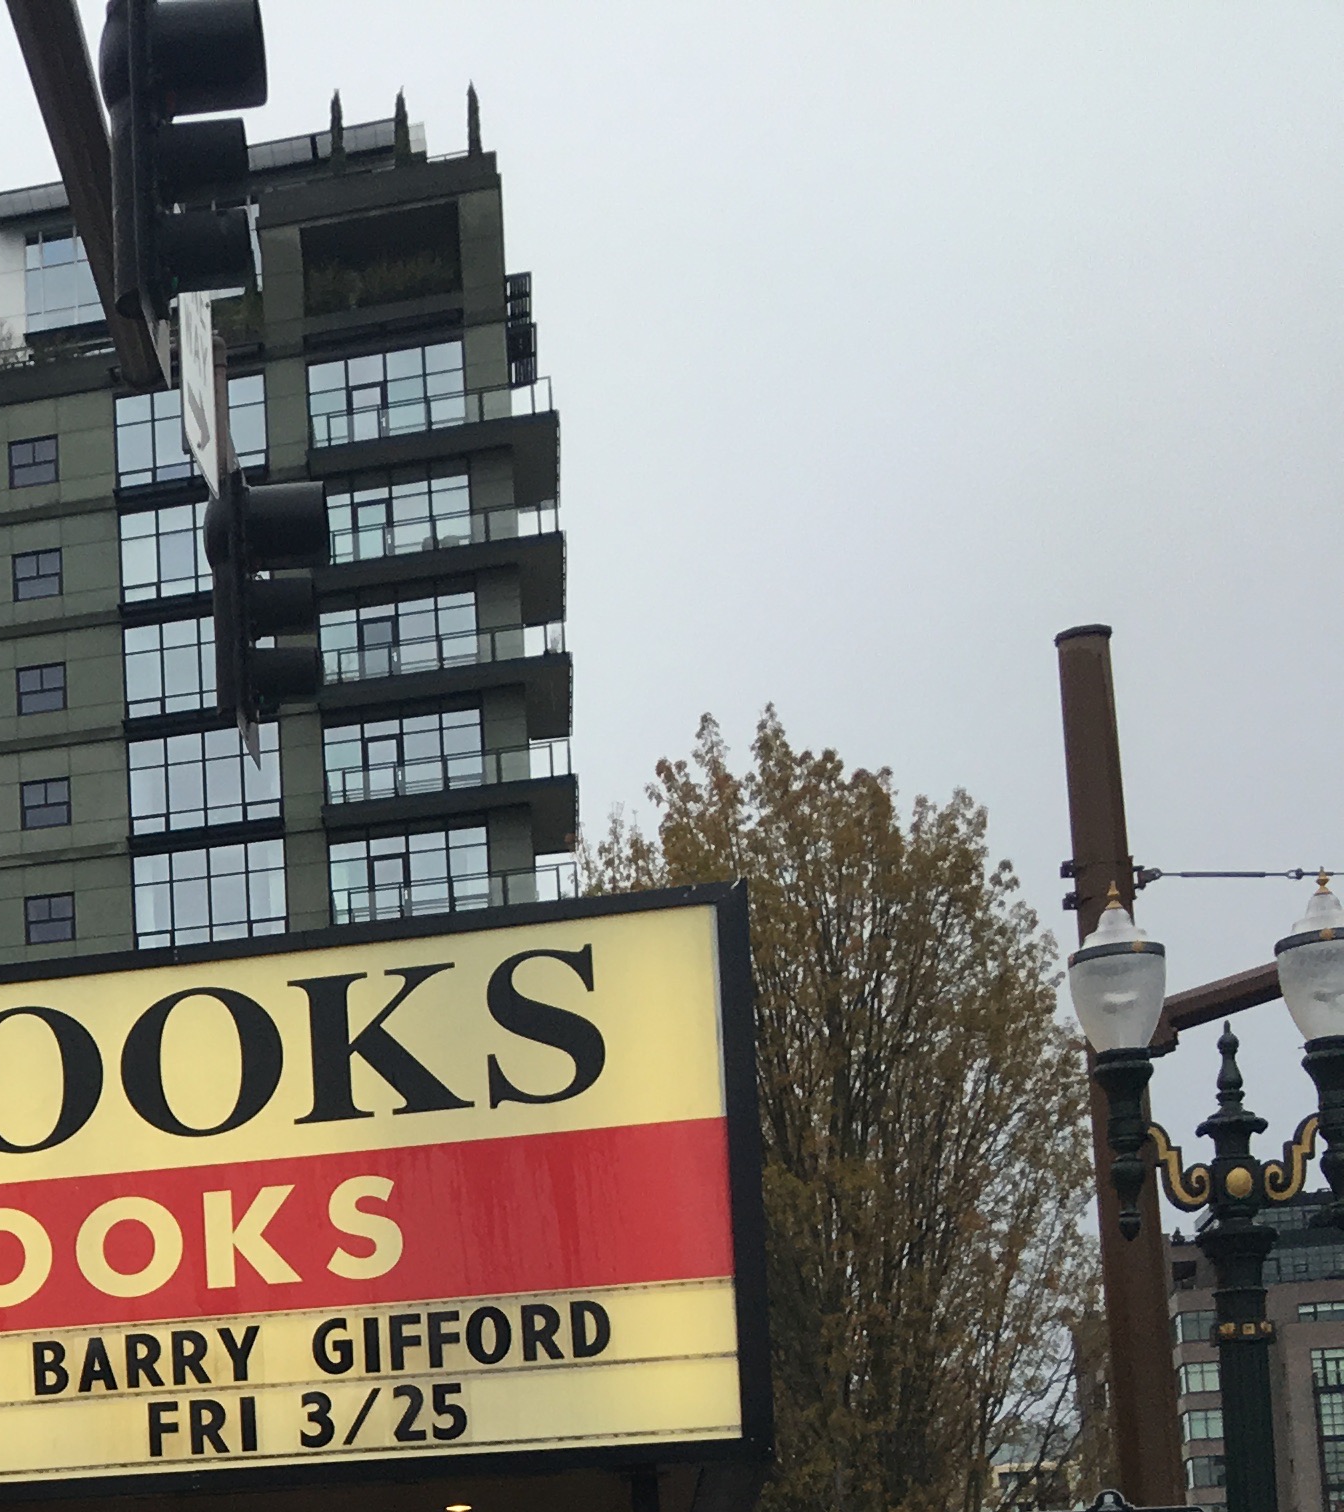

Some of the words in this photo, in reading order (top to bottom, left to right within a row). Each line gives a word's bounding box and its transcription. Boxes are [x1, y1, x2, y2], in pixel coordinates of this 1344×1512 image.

[31, 1324, 261, 1396] BARRY
[311, 1299, 612, 1375] GIFFORD
[146, 1395, 259, 1457] FRI
[298, 1382, 469, 1450] 3/25
